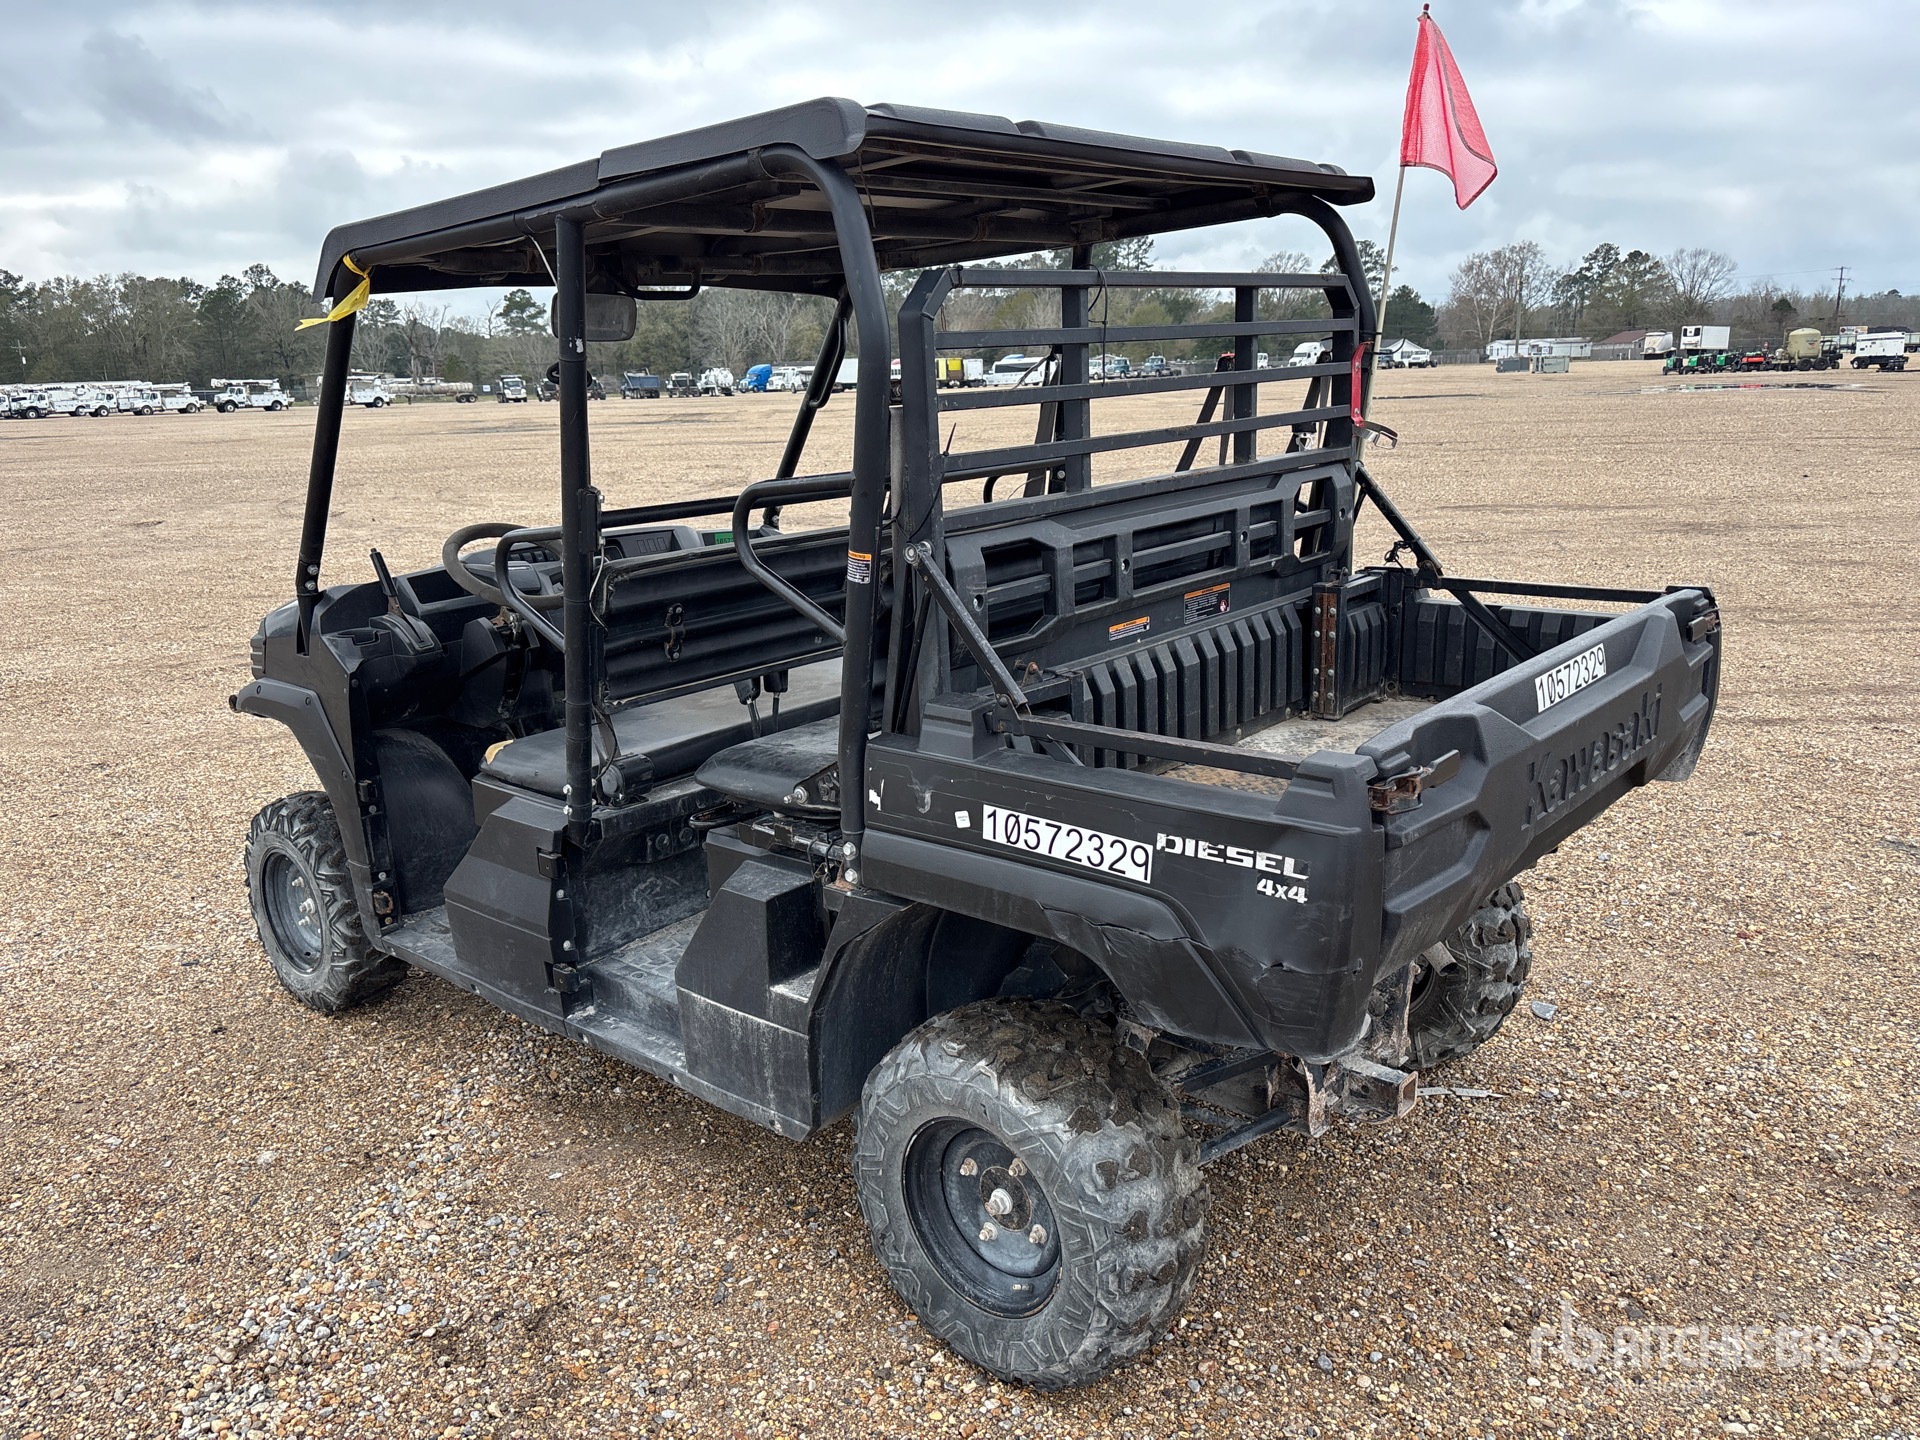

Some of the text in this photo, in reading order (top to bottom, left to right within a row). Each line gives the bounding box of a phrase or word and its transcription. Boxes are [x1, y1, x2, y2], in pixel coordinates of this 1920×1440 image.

[1538, 646, 1606, 709] 10572329
[1520, 682, 1663, 831] Kawasaki
[987, 809, 1150, 881] 10572329
[1156, 832, 1310, 880] DIESEL
[1256, 878, 1309, 905] 4x4
